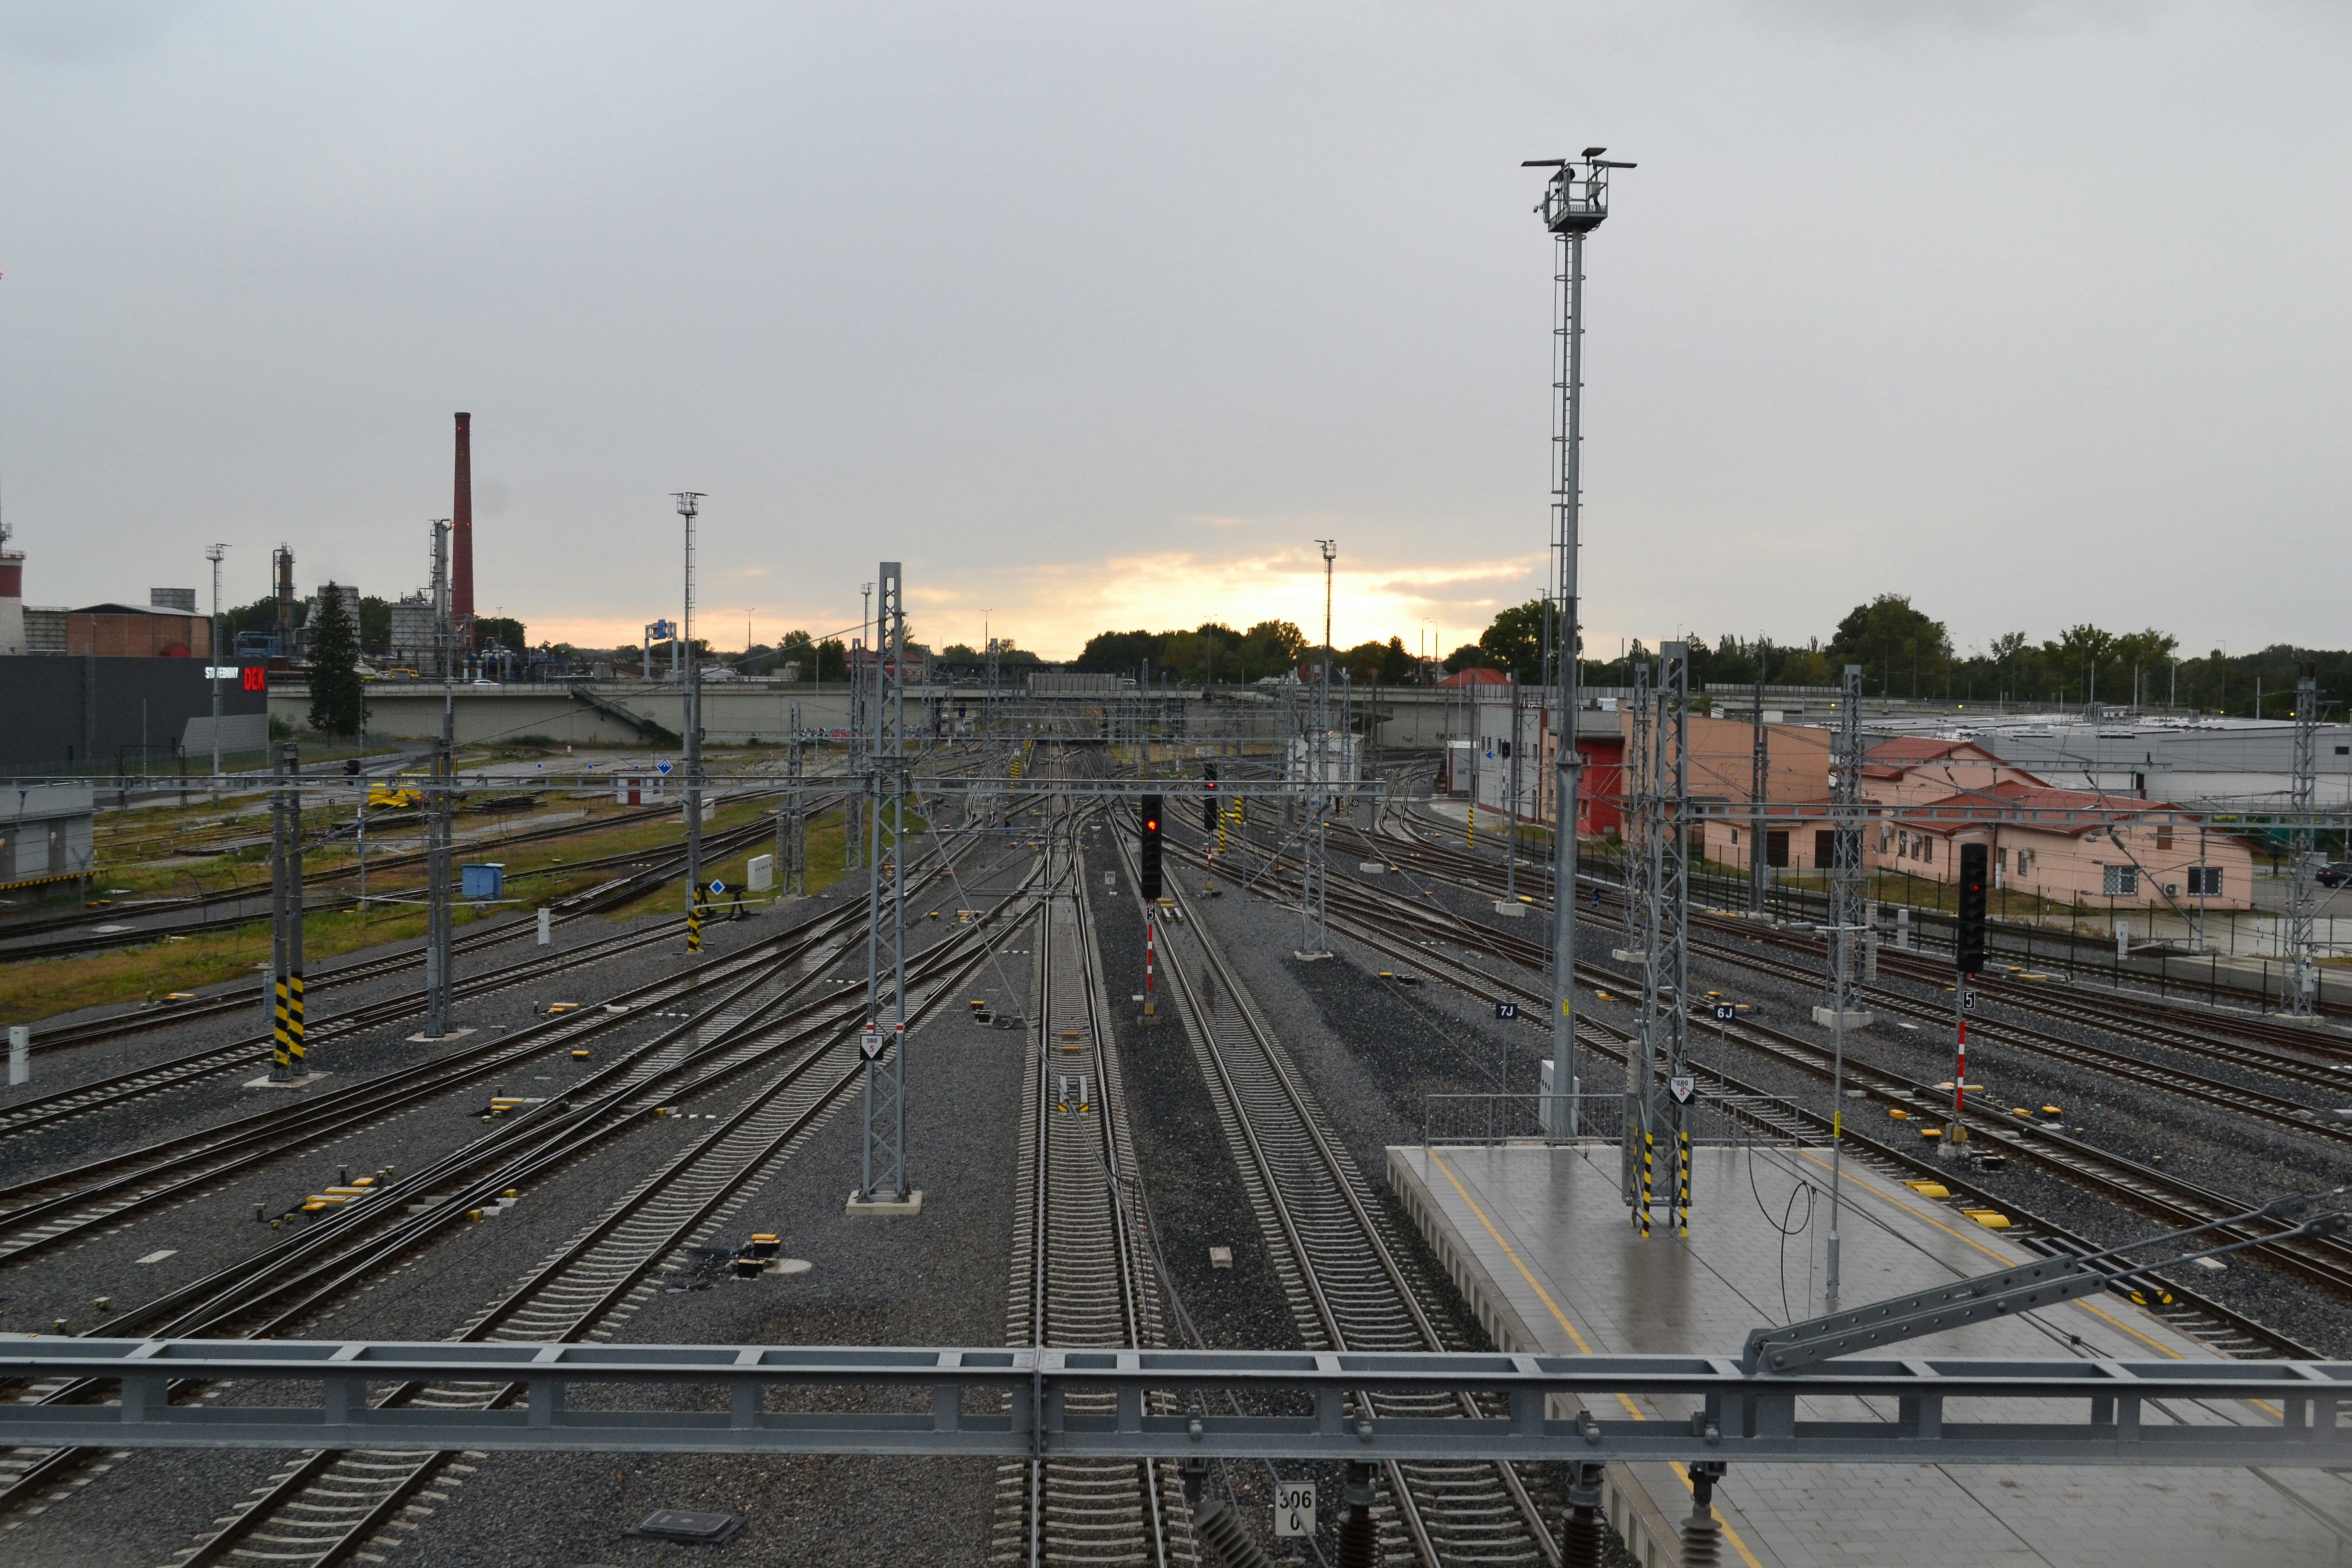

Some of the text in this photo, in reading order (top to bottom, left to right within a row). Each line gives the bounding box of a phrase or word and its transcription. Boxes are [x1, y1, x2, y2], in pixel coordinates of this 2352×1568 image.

[244, 667, 265, 691] DEK
[1148, 908, 1154, 919] 5
[1966, 992, 1972, 1008] 5
[1500, 1006, 1513, 1016] 7J
[1718, 1008, 1732, 1018] 6J
[1279, 1490, 1312, 1509] 306
[1290, 1513, 1301, 1531] 0
